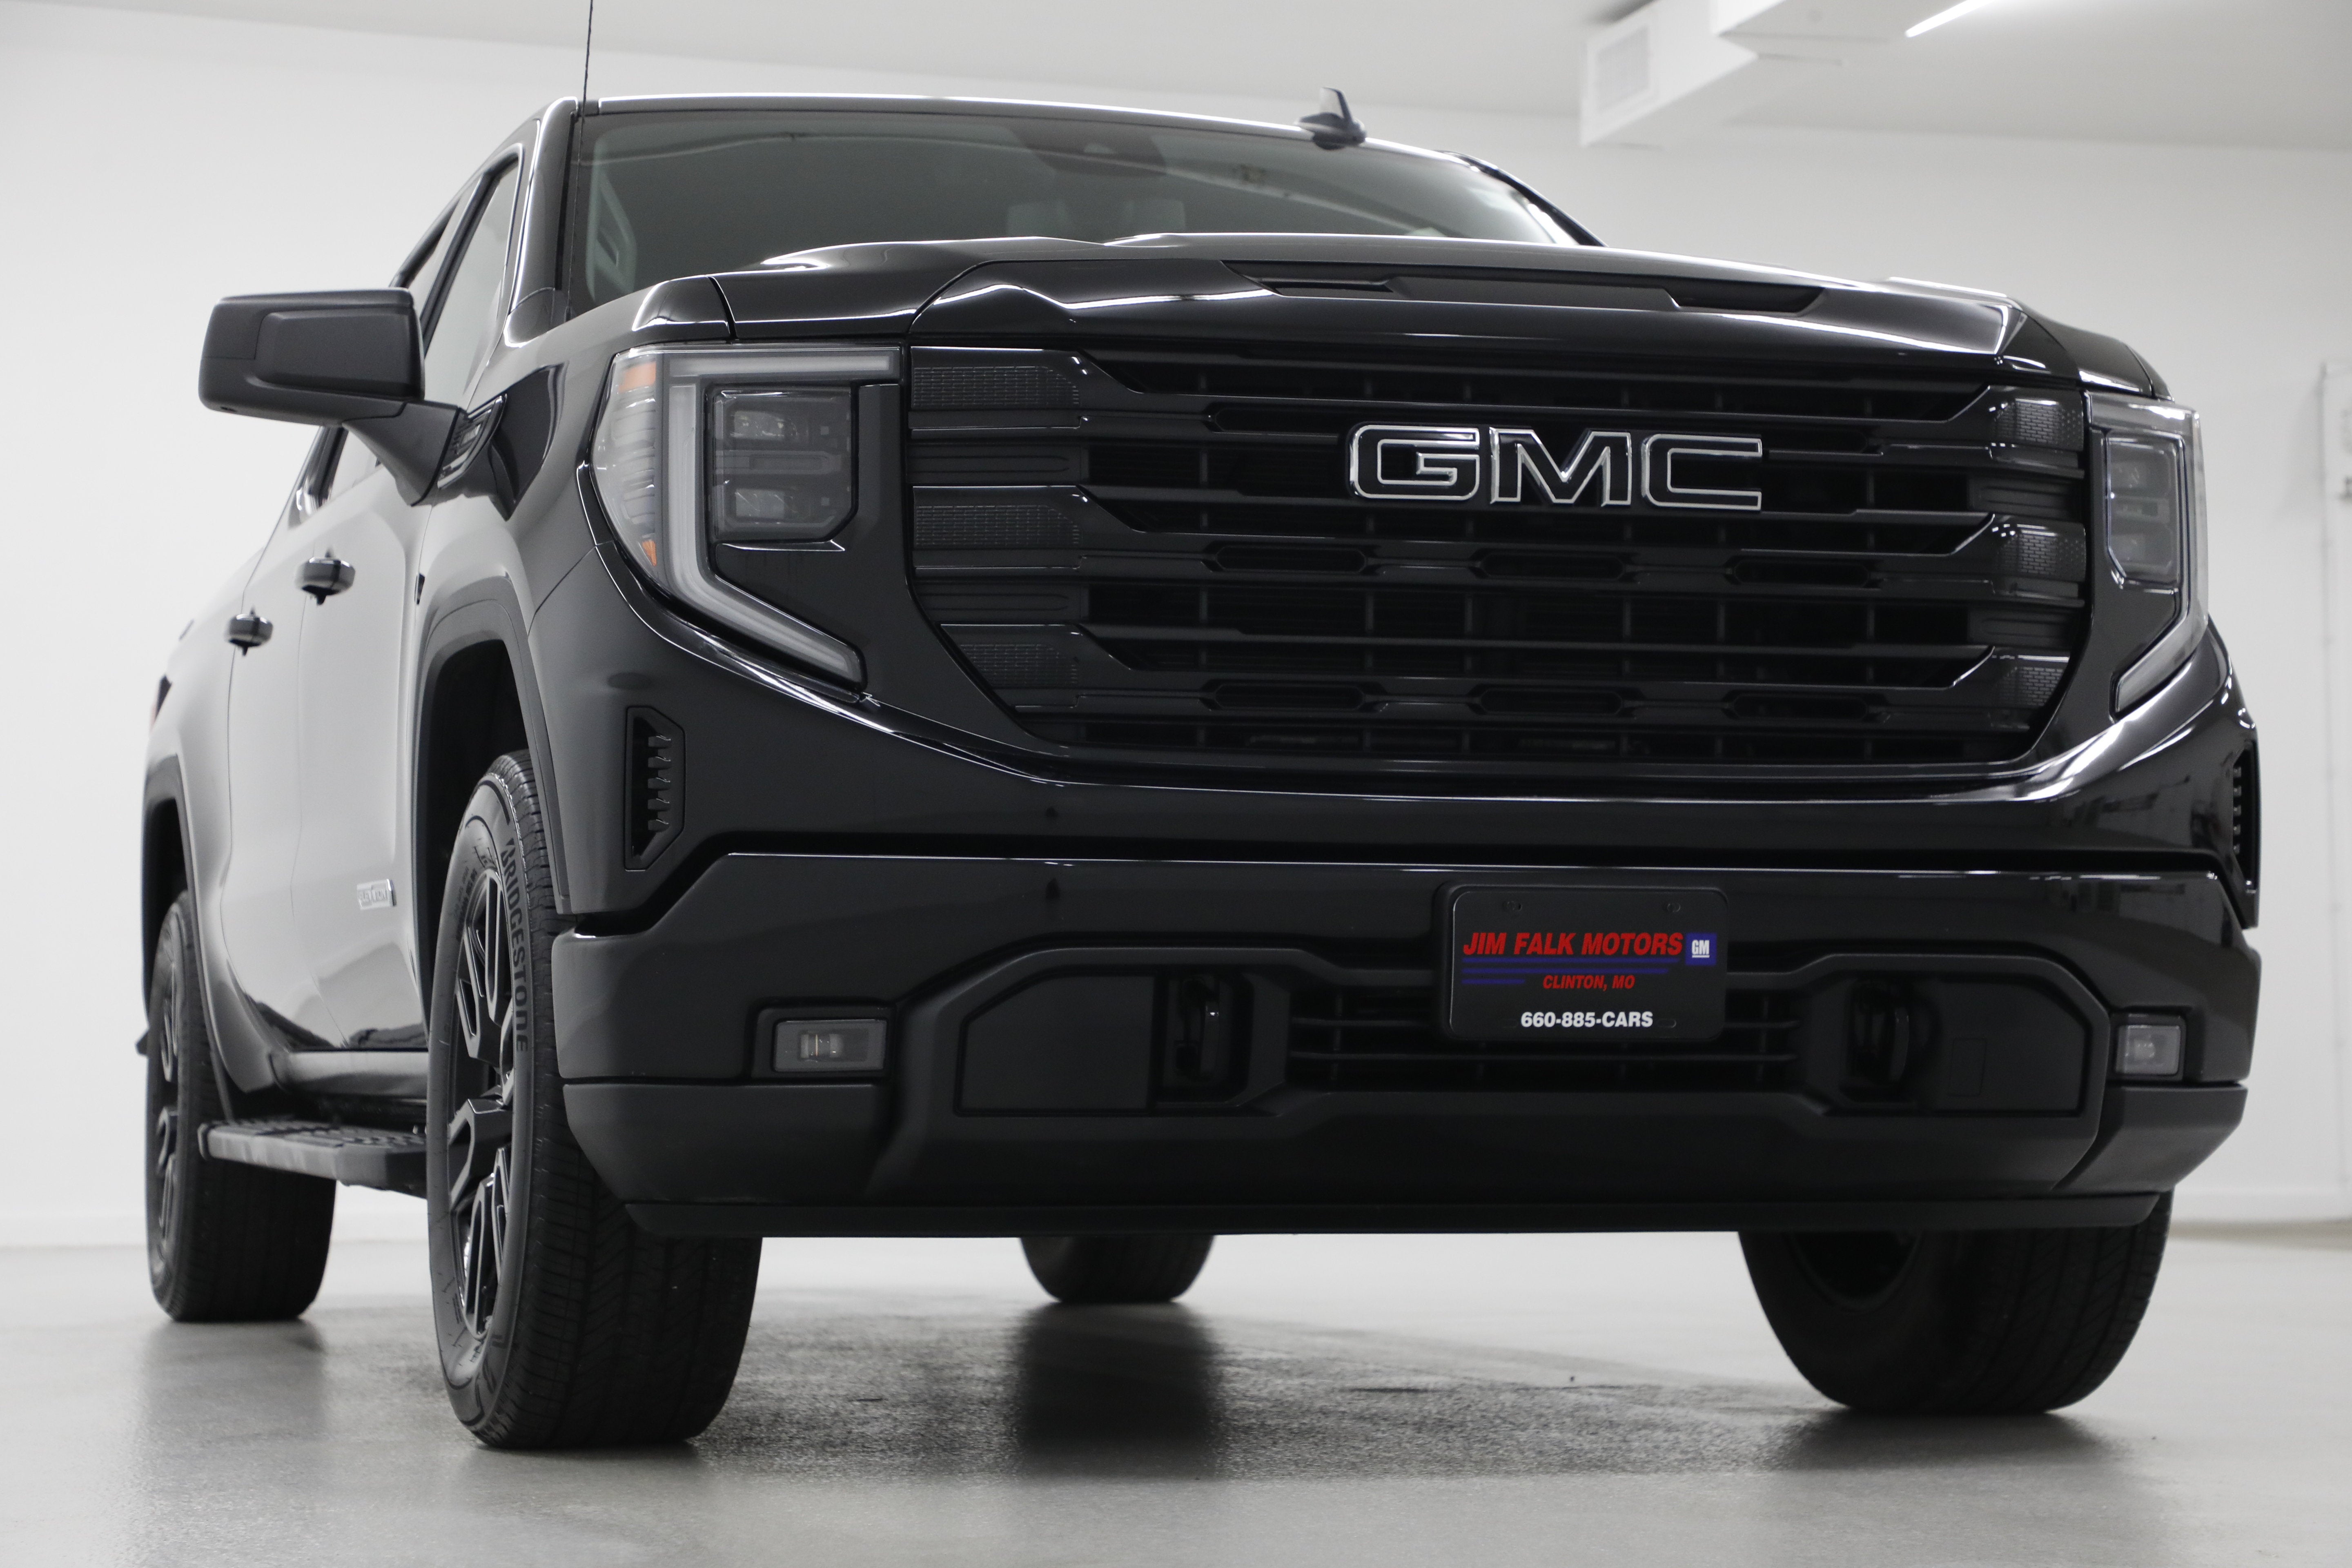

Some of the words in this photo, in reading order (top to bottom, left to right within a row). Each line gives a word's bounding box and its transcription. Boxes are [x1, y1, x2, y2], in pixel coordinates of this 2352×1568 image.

[1349, 424, 1763, 511] GMC
[1463, 932, 1507, 955] JIM
[1514, 932, 1576, 955] FALK
[1581, 932, 1684, 956] MOTORS
[1691, 940, 1710, 955] GM
[1543, 975, 1608, 991] CLINTON,
[1612, 975, 1635, 989] MO
[1521, 1011, 1653, 1027] 660-885-CARS
